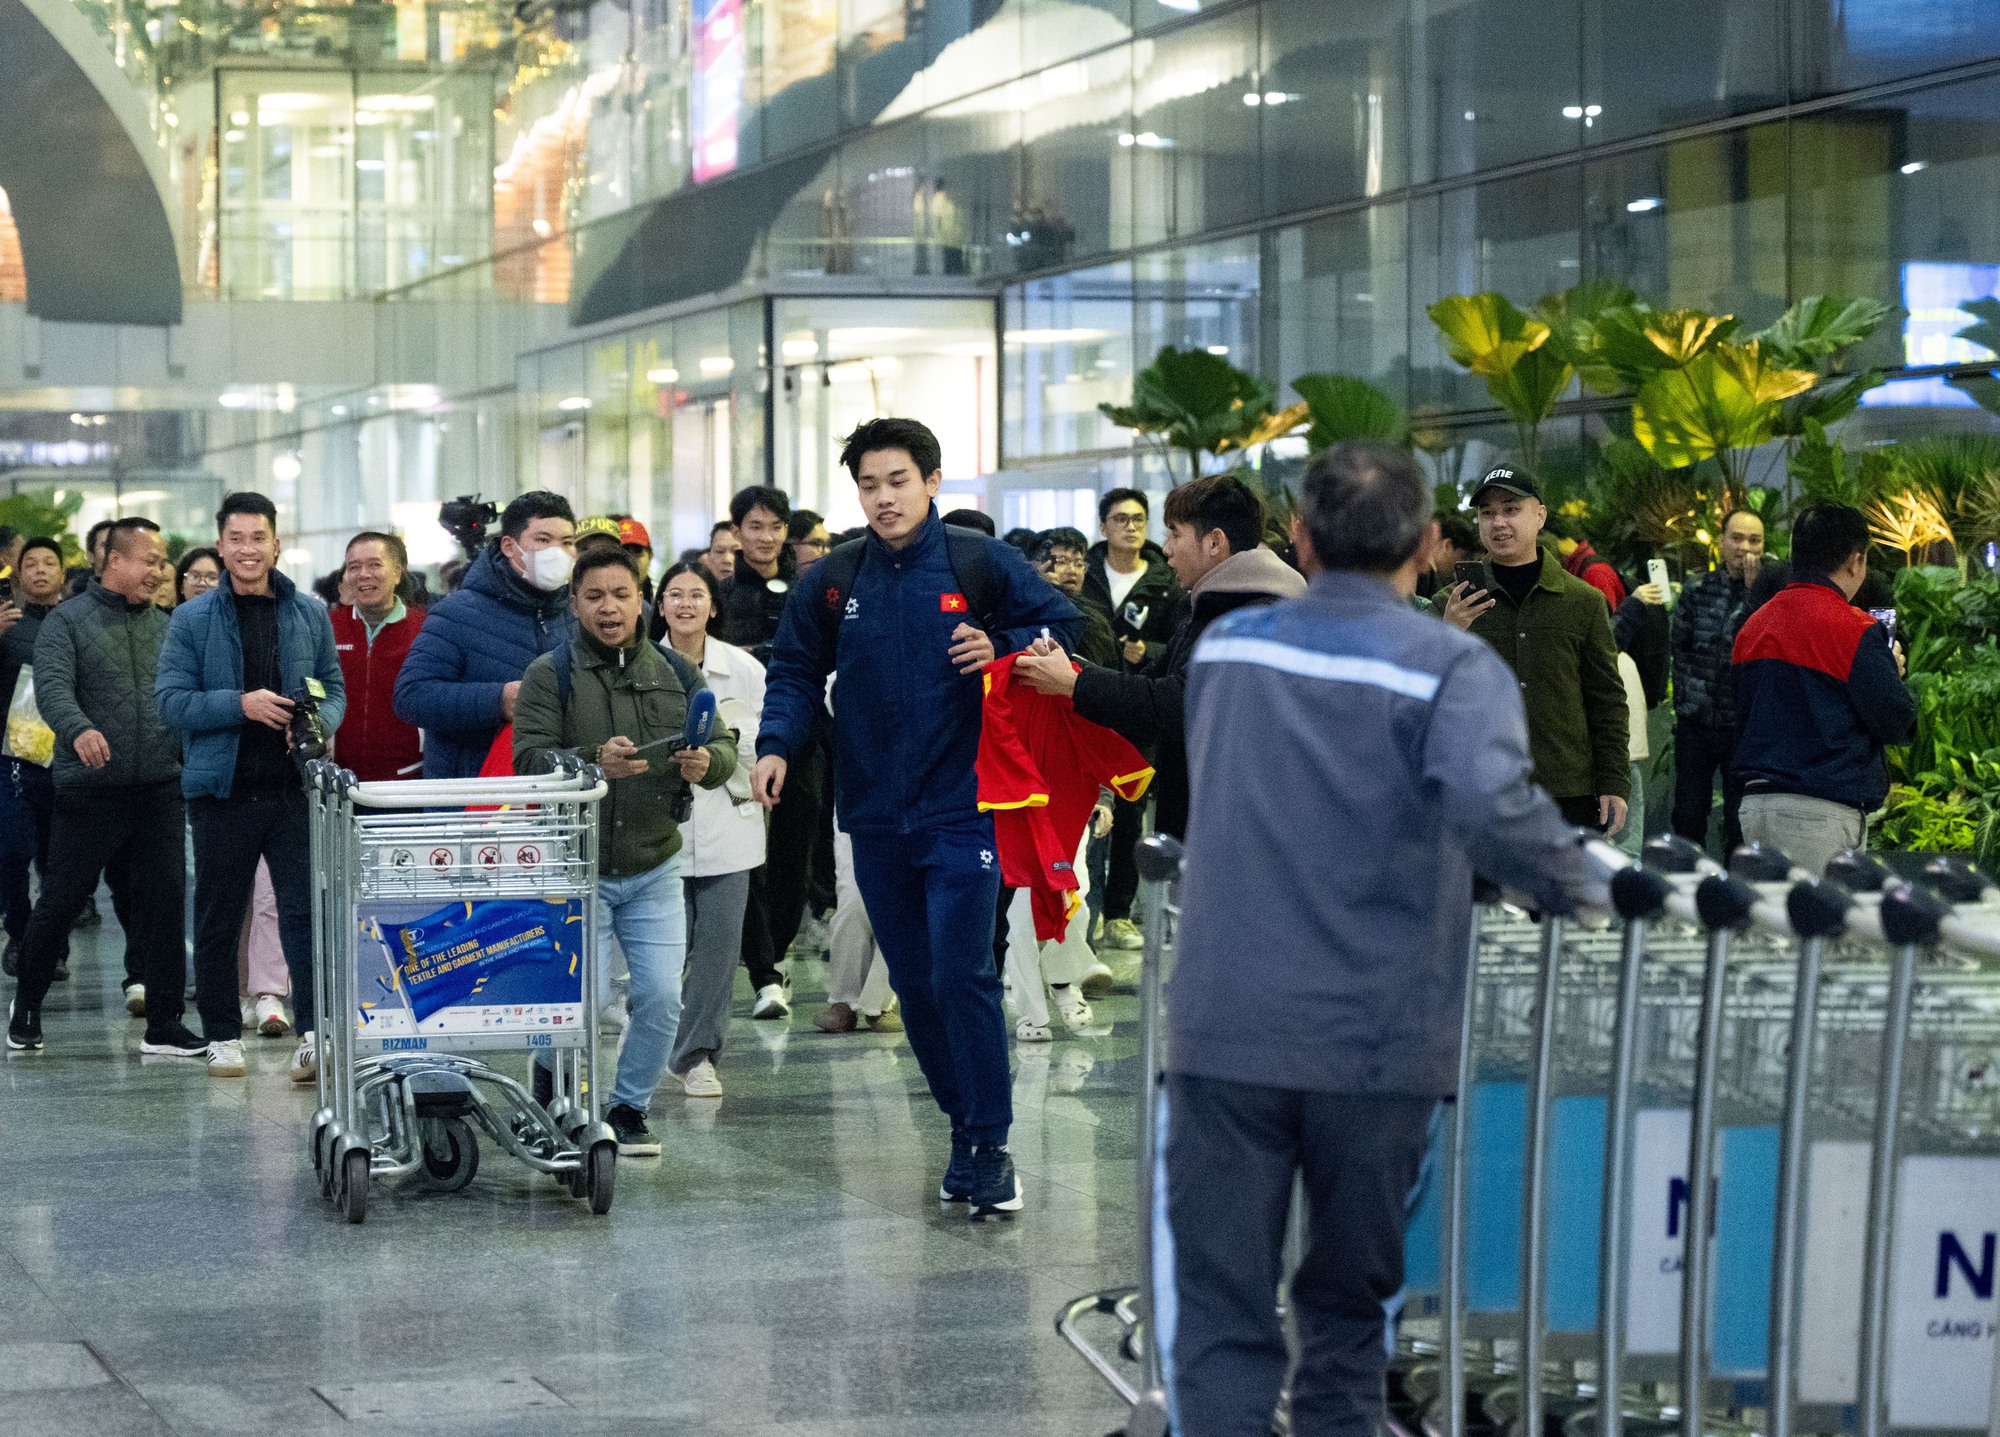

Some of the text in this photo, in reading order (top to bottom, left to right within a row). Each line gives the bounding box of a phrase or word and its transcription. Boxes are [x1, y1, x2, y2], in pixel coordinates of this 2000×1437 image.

[404, 938, 479, 975] ONE OF THE LEADING
[407, 925, 546, 986] TEXTILE AND GARMENT MANUFACTURERS
[382, 1034, 552, 1051] BIZMAN 1405
